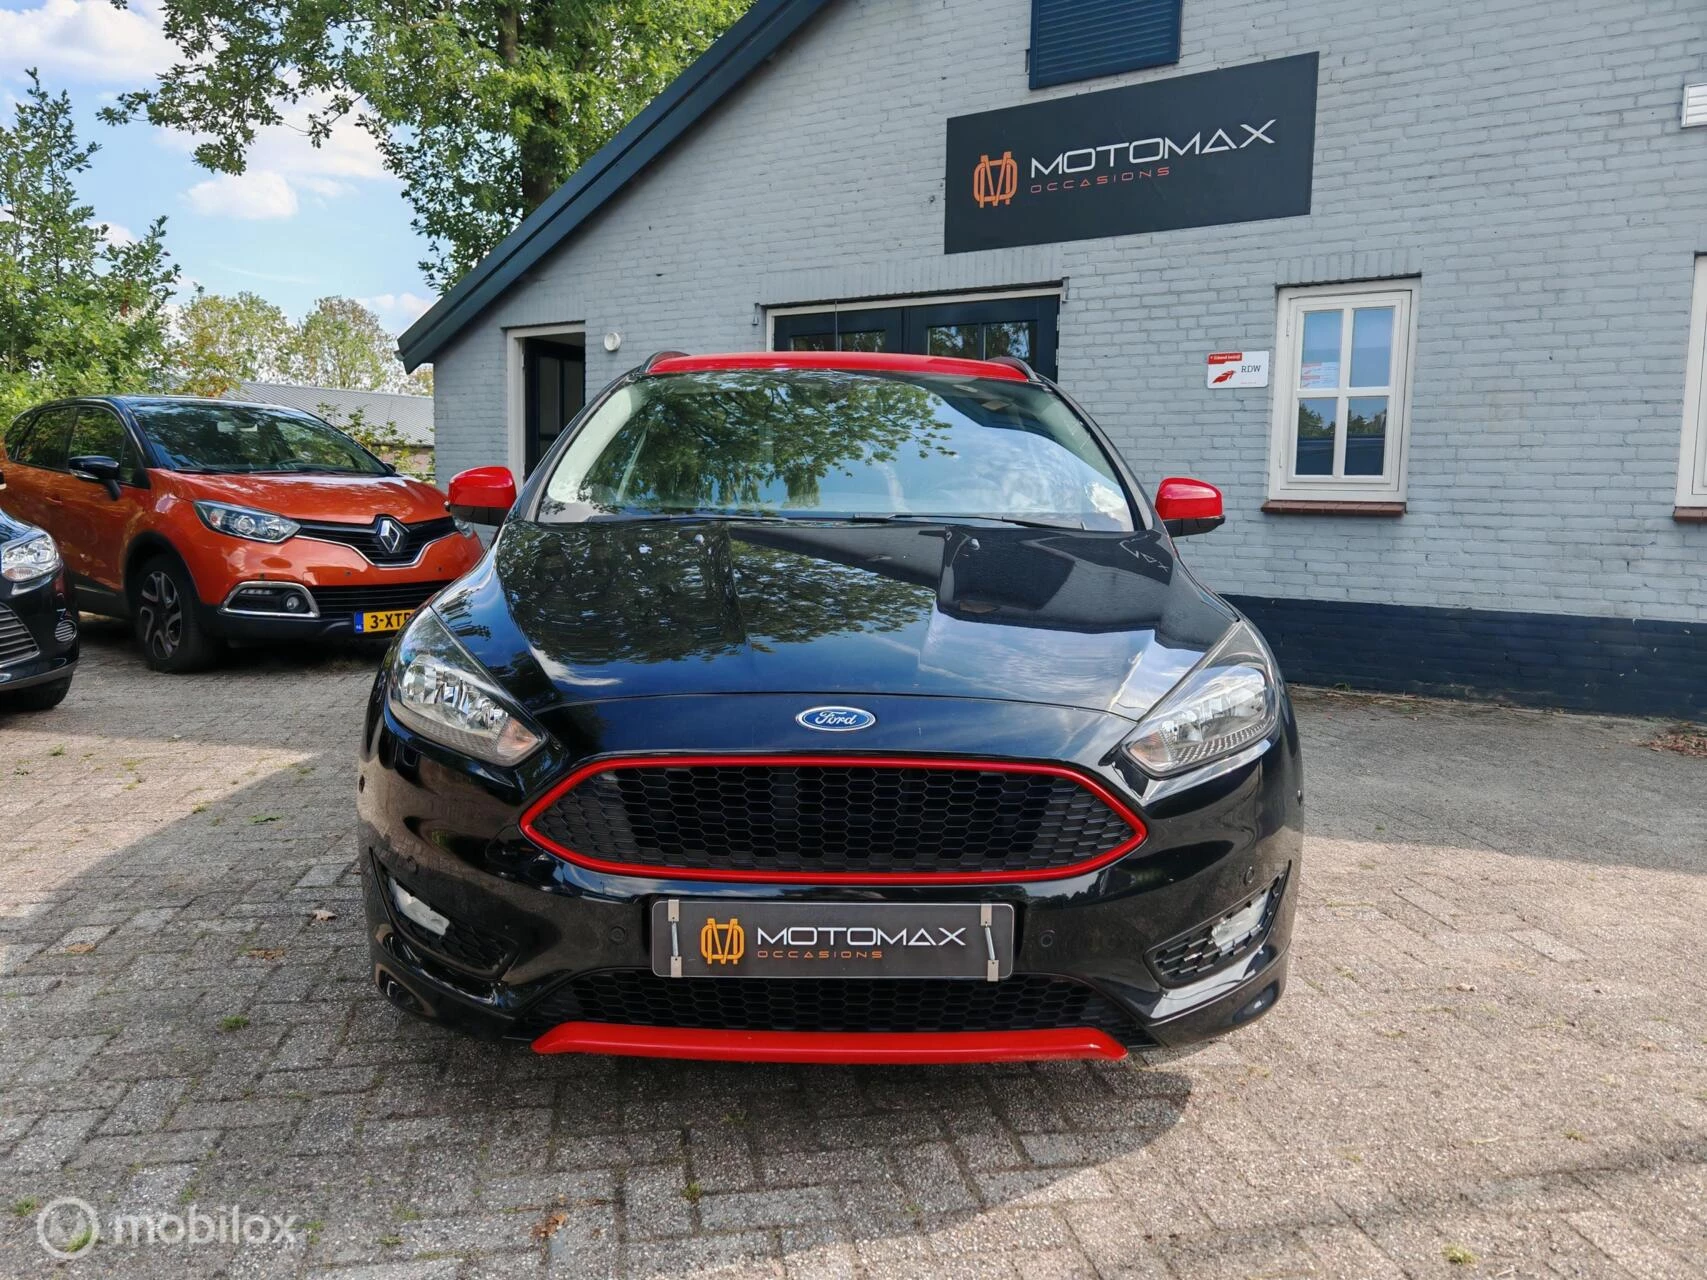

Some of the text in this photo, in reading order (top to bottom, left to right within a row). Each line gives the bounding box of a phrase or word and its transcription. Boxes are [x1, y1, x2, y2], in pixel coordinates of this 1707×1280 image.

[1030, 118, 1277, 178] MOTOMAX
[1030, 167, 1170, 193] OCCASIONS
[1240, 364, 1261, 373] RDW
[815, 711, 856, 725] Ford
[757, 927, 966, 946] MOTOMAX
[757, 950, 883, 959] OCCASIONS
